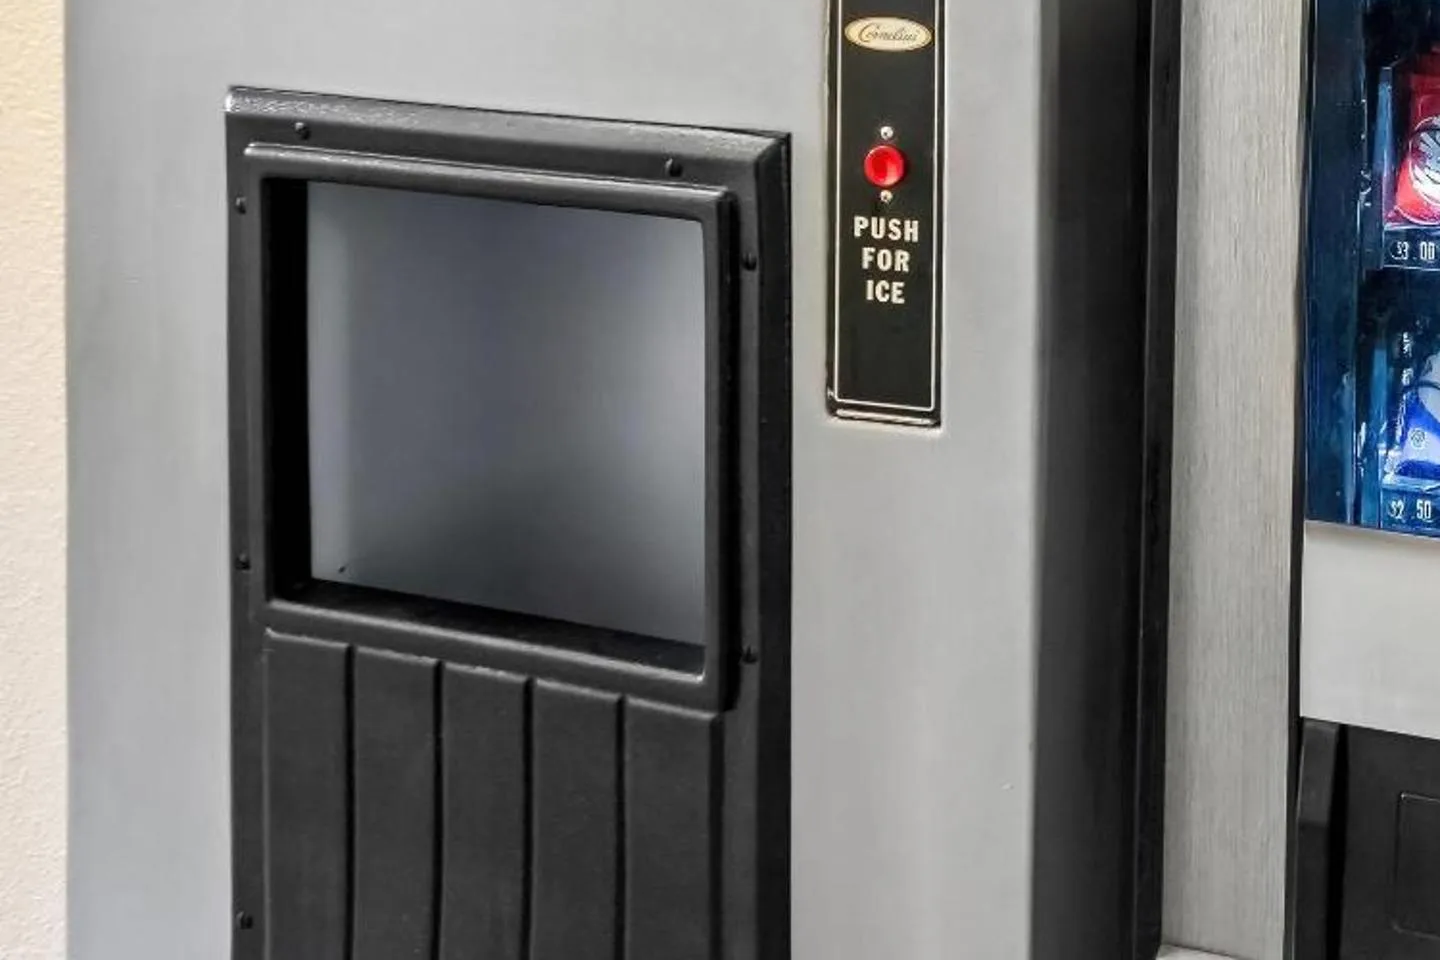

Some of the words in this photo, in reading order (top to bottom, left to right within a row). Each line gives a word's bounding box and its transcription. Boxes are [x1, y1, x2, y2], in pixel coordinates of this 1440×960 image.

[853, 215, 920, 243] PUSH
[861, 246, 911, 273] FOR
[866, 279, 906, 305] ICE
